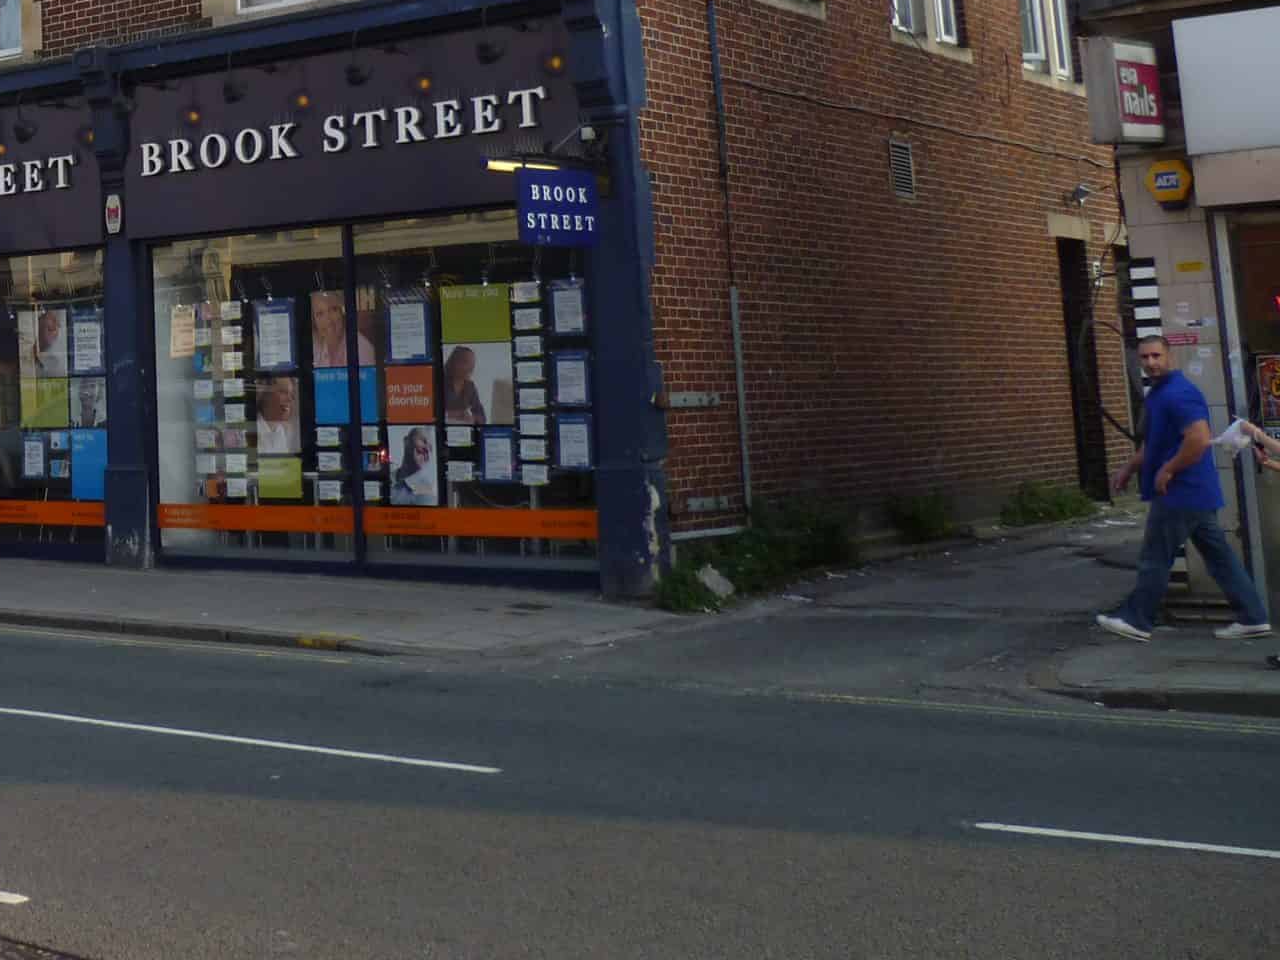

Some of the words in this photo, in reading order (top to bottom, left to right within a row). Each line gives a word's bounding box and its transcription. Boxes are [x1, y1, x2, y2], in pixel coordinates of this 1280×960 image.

[1120, 68, 1138, 84] eva
[1124, 86, 1157, 117] nails
[140, 124, 298, 177] BROOK
[322, 86, 545, 153] STREET
[1155, 175, 1177, 187] ADT
[531, 184, 588, 204] BROOK
[527, 212, 595, 232] STREET
[388, 384, 400, 393] on
[401, 384, 423, 394] your
[388, 394, 431, 408] doorstep
